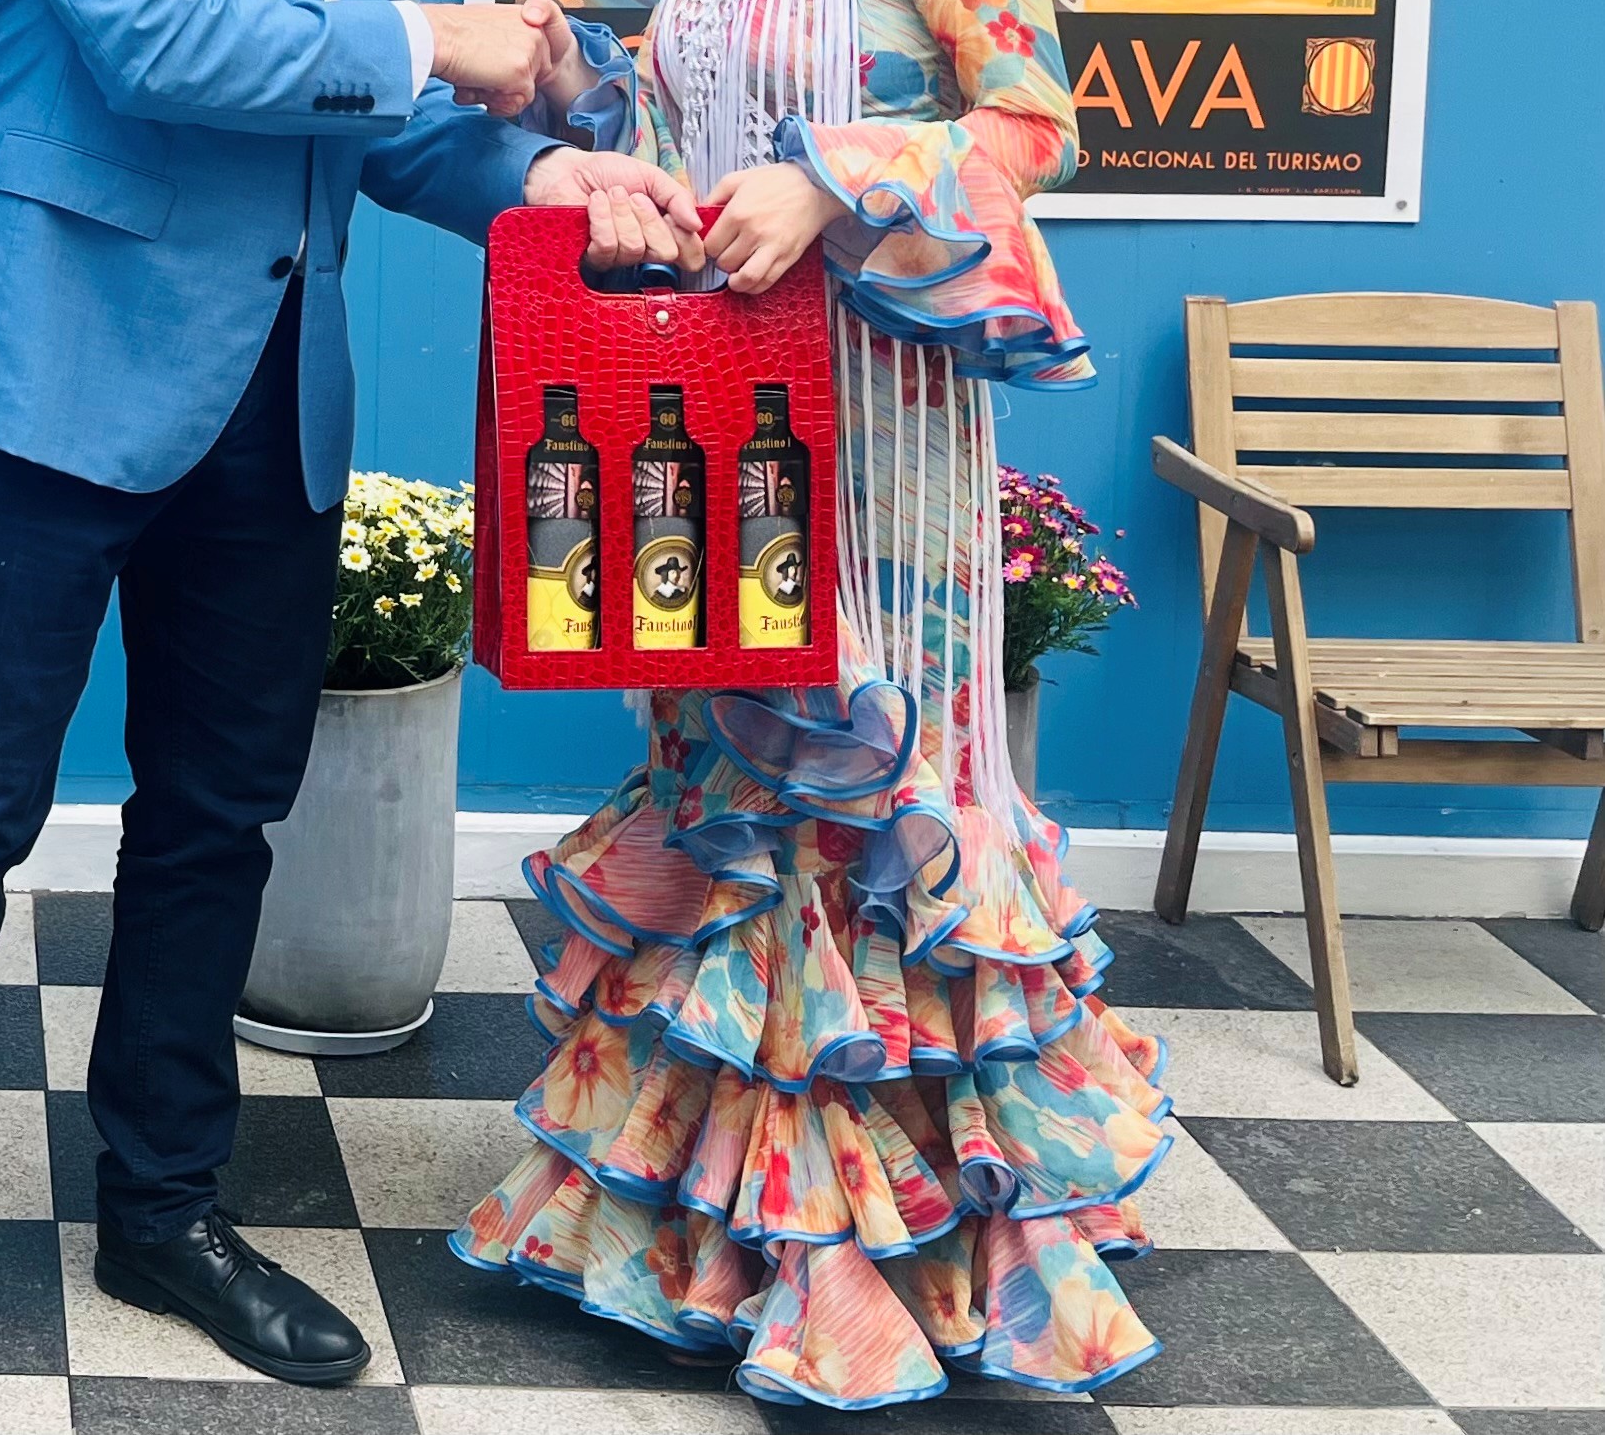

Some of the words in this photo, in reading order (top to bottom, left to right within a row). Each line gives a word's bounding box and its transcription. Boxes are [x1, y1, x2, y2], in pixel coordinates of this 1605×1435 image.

[1072, 39, 1266, 130] AVA
[1101, 149, 1216, 170] NACIONAL
[1224, 151, 1258, 171] DEL
[1265, 151, 1363, 172] TURISMO
[561, 413, 578, 427] 60
[659, 412, 677, 426] 60
[642, 437, 688, 452] Faustino
